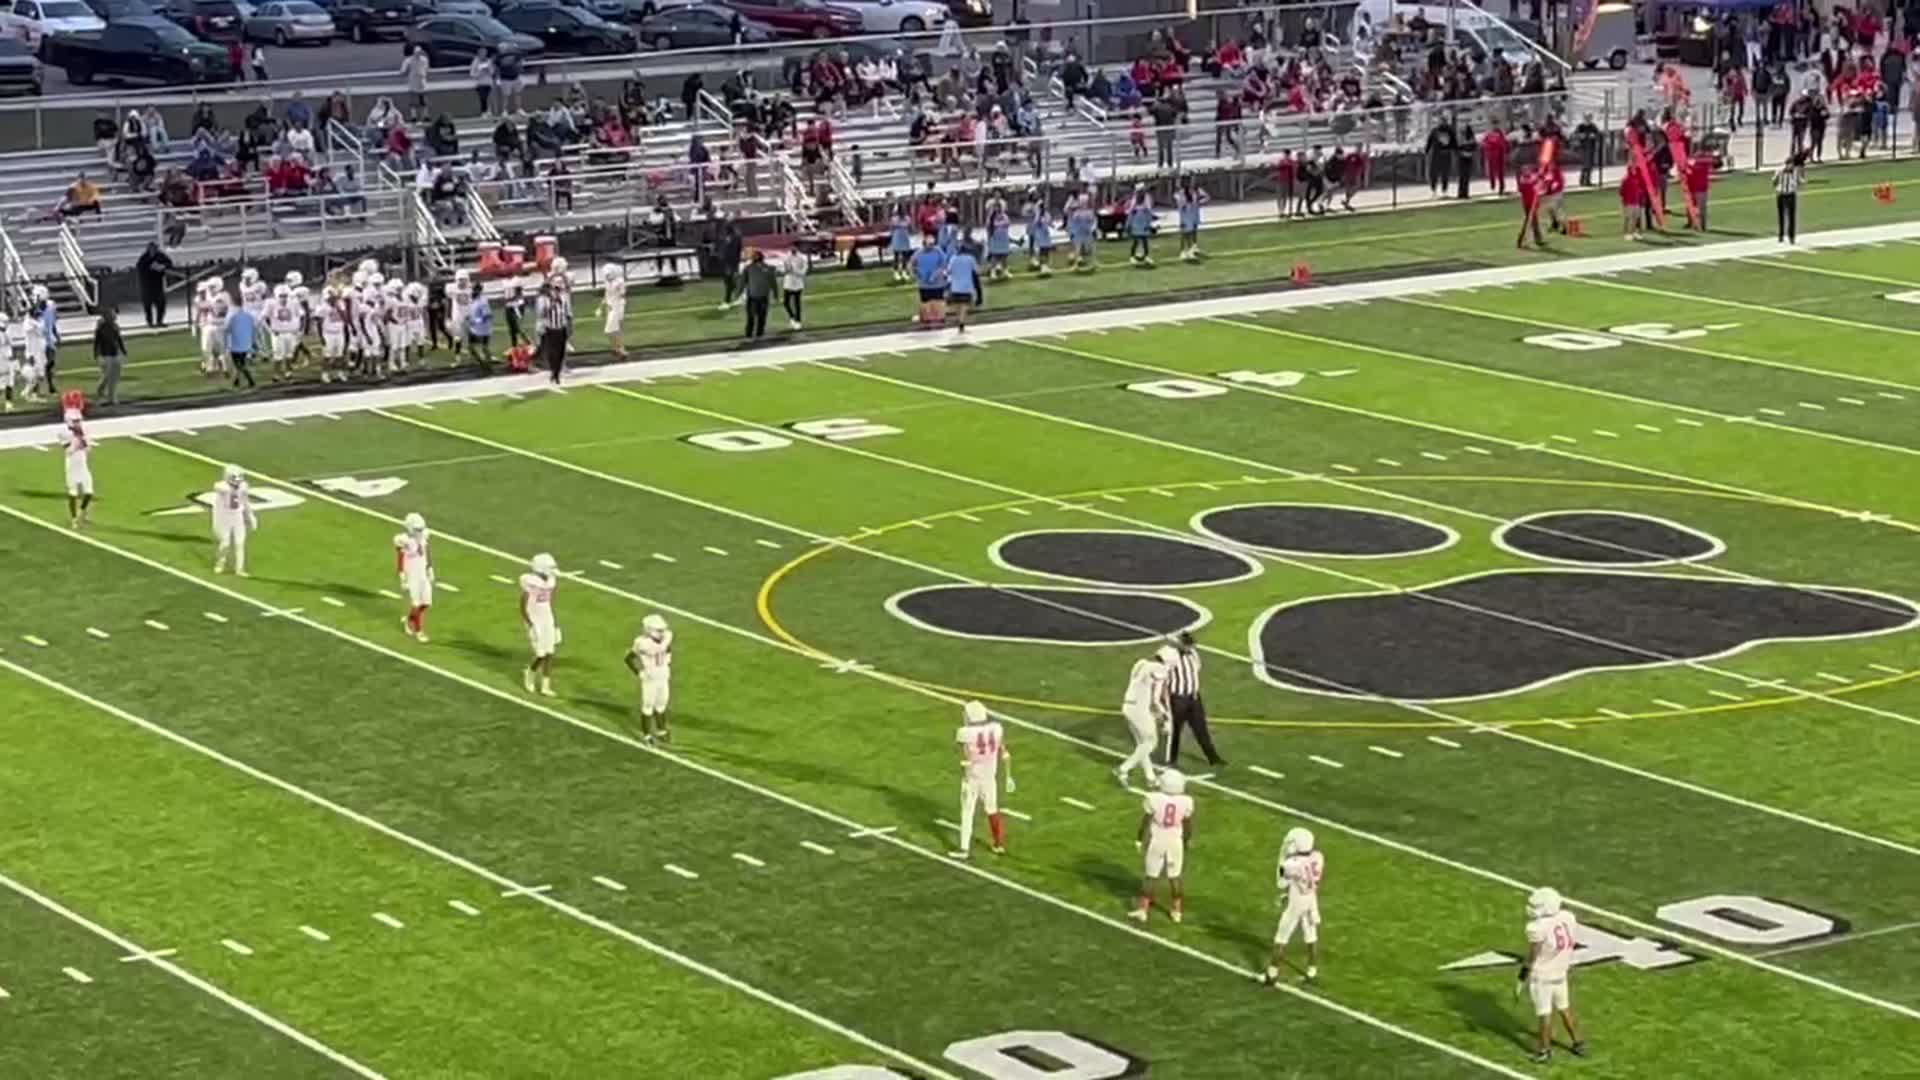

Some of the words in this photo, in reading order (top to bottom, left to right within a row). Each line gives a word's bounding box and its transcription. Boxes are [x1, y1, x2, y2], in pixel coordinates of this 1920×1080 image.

[688, 418, 904, 452] 50
[976, 732, 996, 755] 44
[1163, 803, 1176, 828] 8
[1553, 921, 1573, 951] 61
